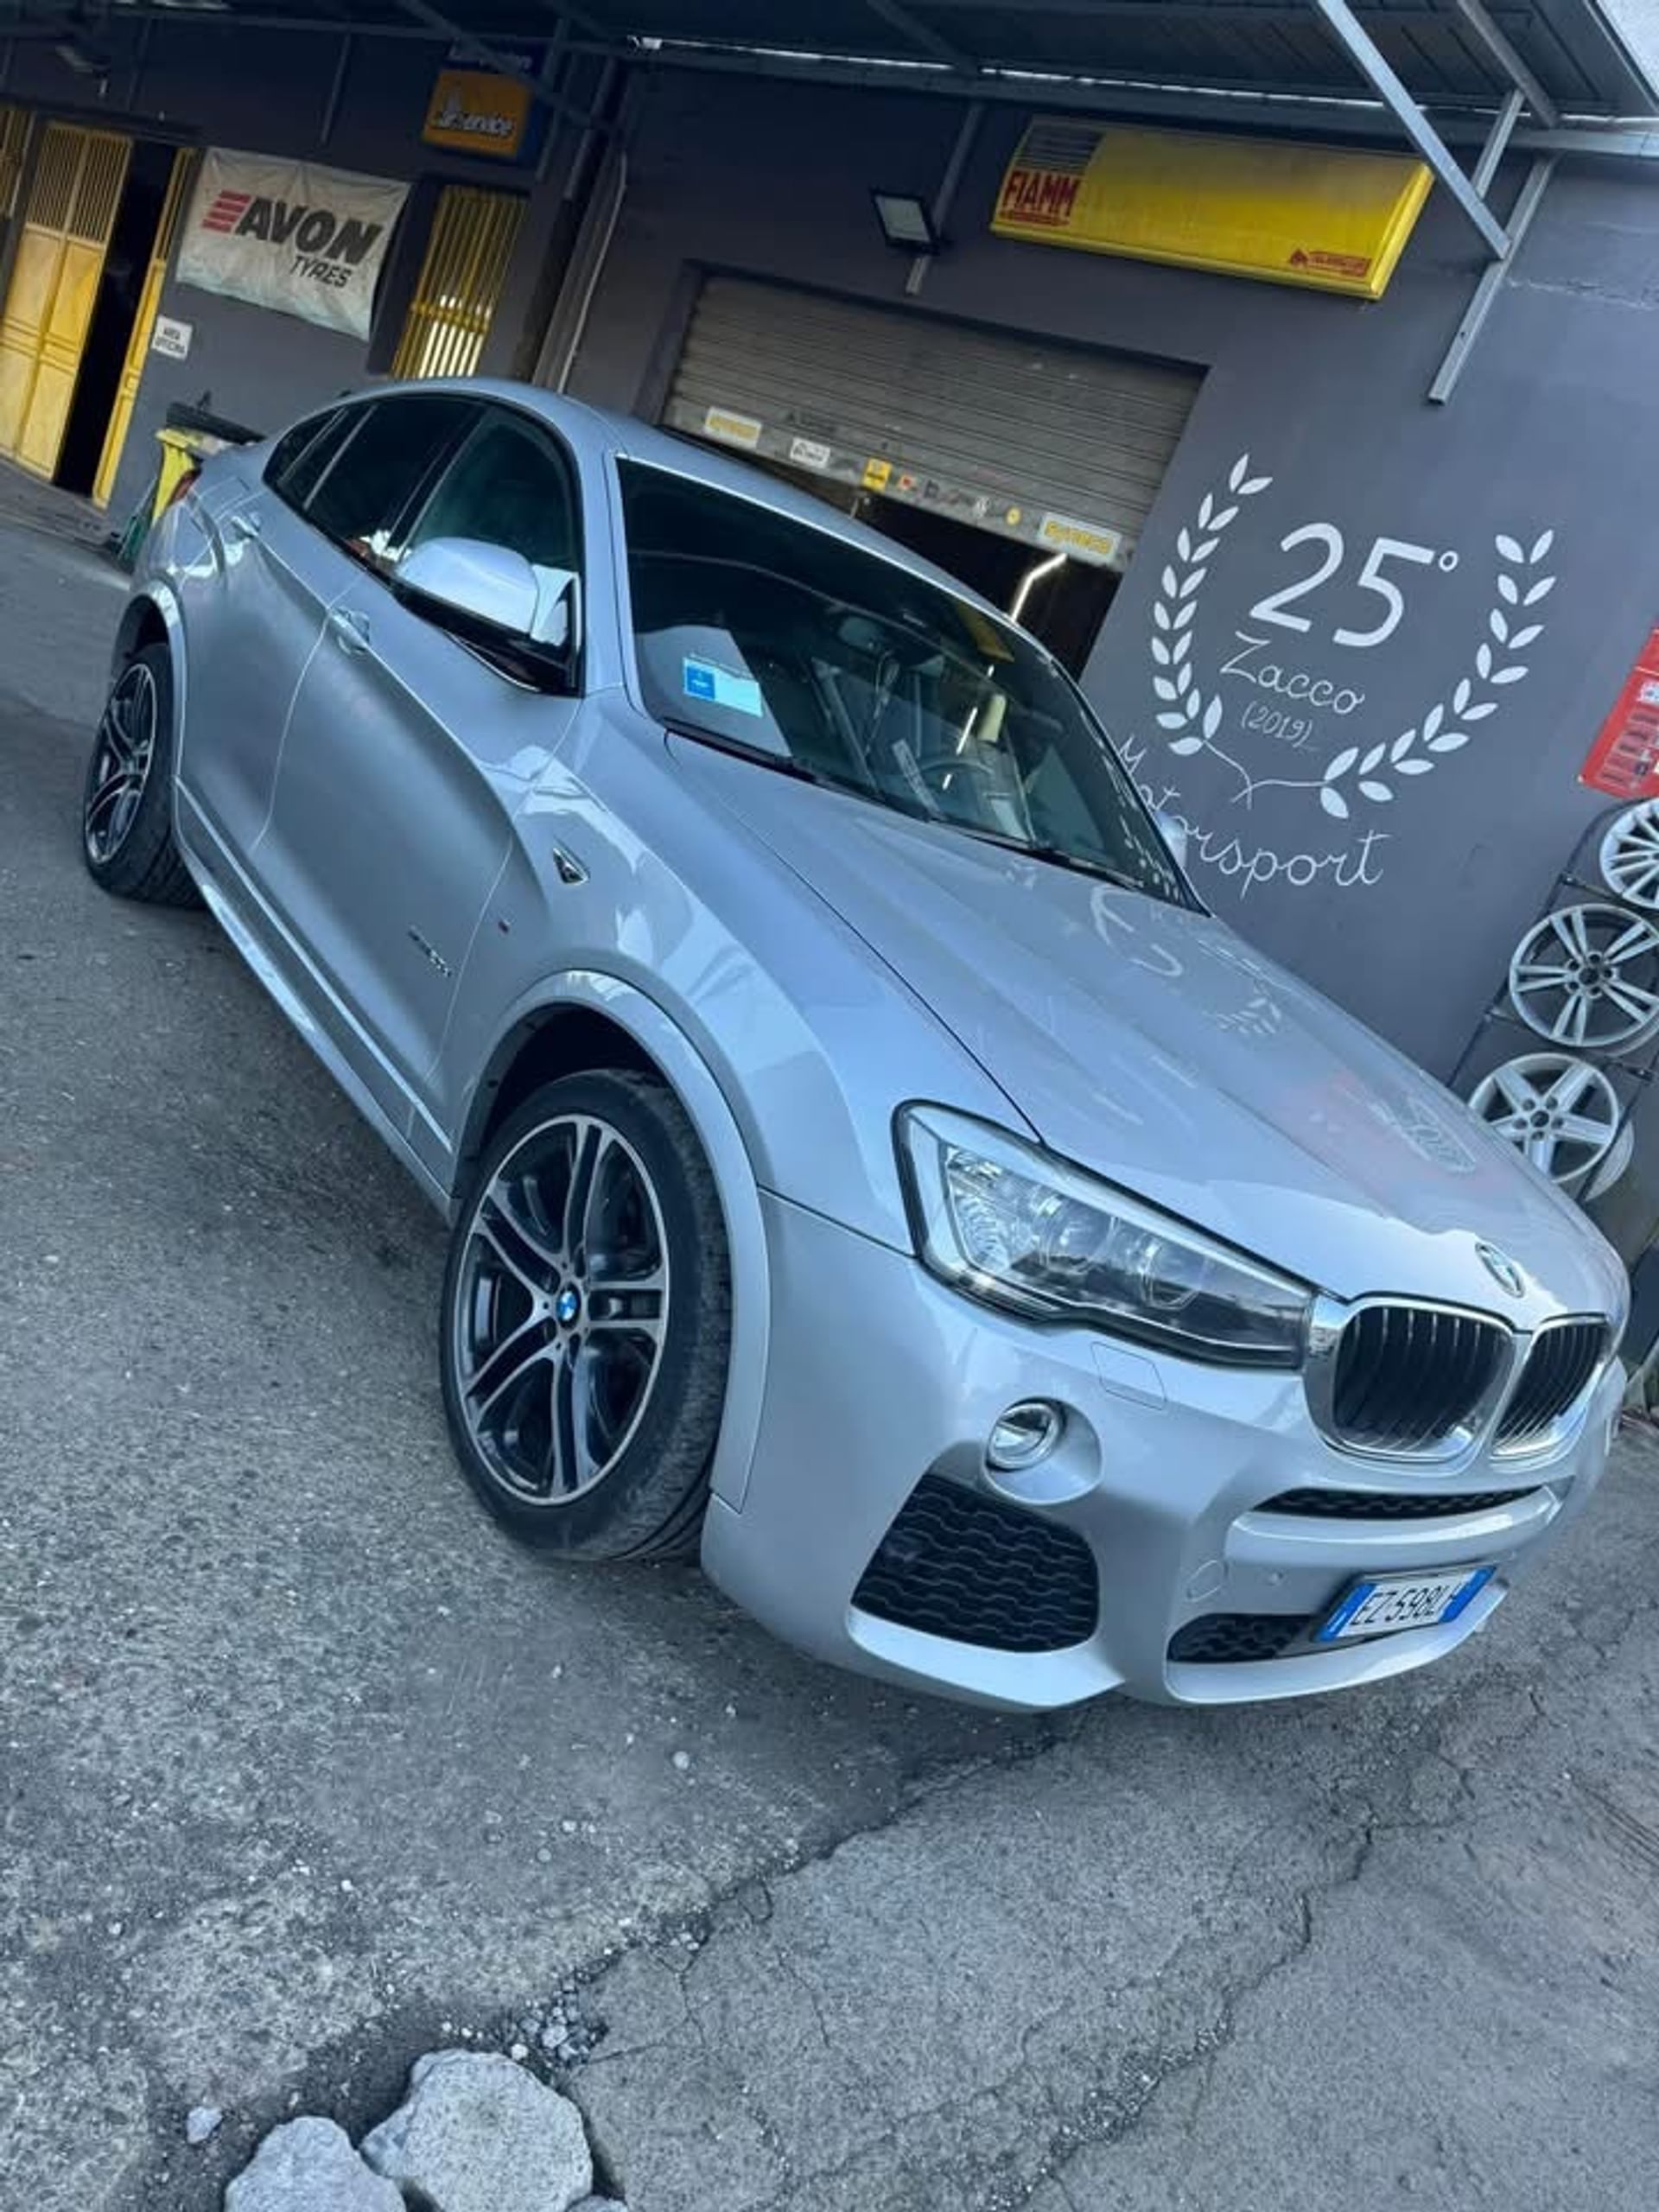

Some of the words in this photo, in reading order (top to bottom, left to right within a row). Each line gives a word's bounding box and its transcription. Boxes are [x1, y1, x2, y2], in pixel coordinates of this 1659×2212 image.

[1002, 170, 1081, 217] FIAMM
[235, 195, 384, 266] AVON
[289, 256, 353, 288] TYRES
[1219, 631, 1365, 714] Zacco
[1241, 701, 1313, 747] (2019)
